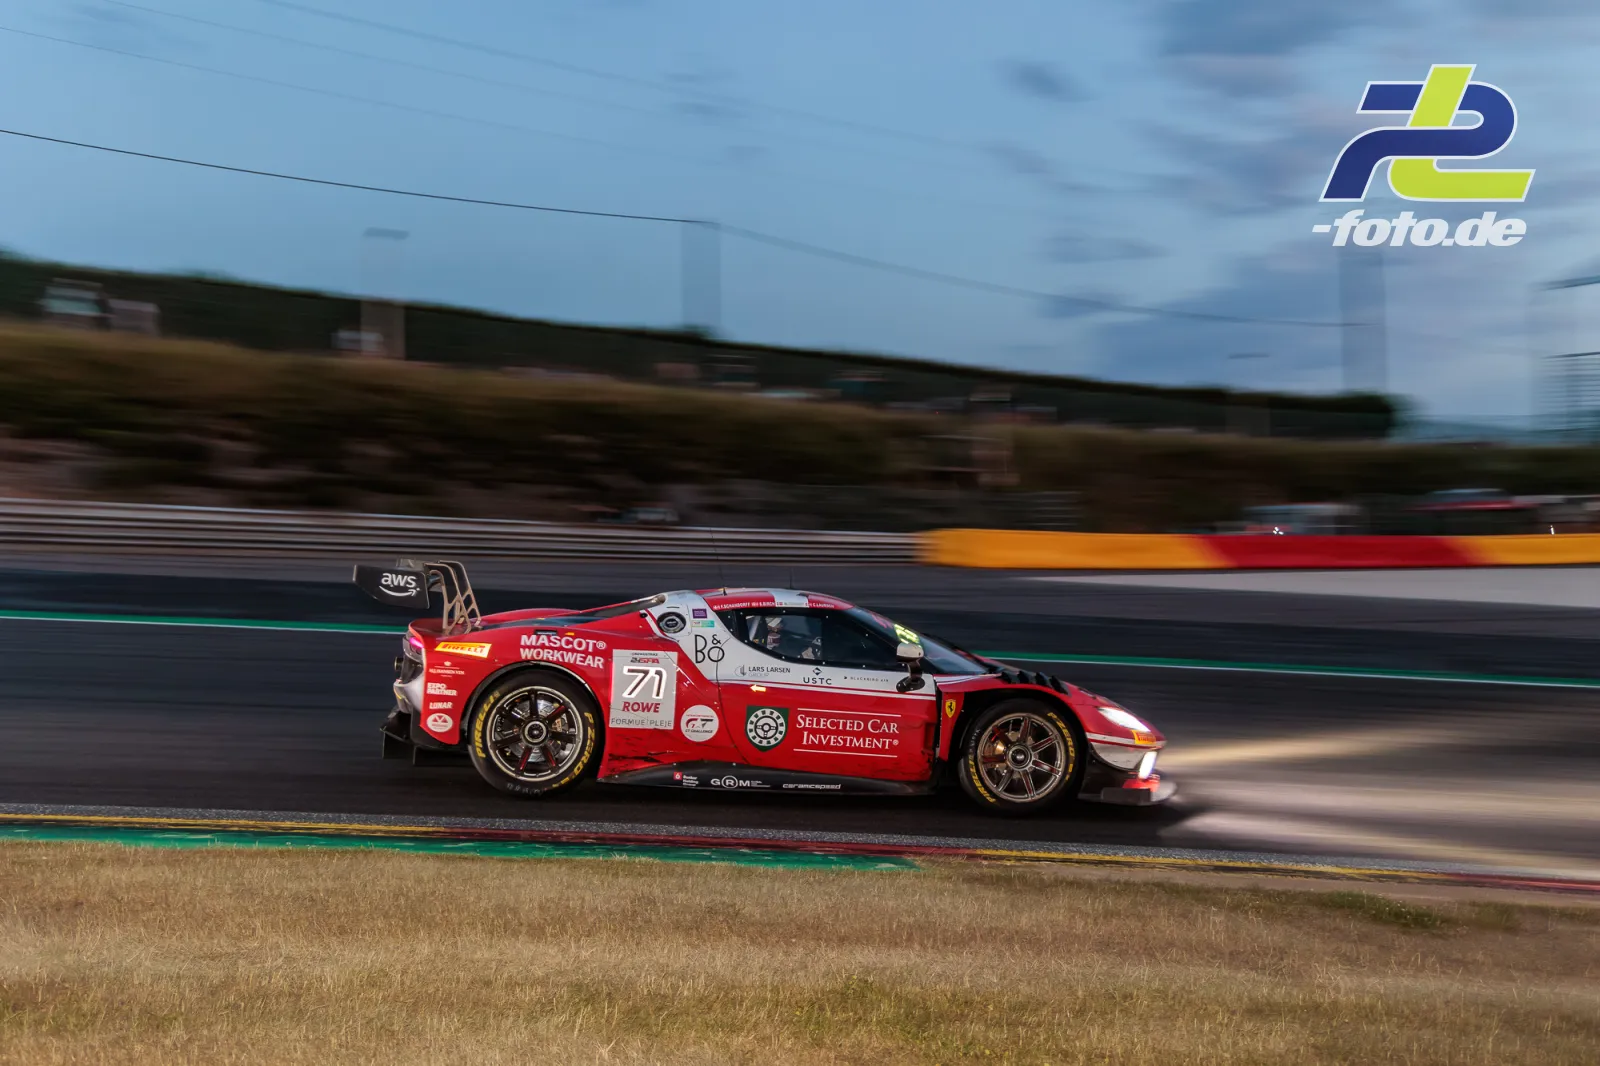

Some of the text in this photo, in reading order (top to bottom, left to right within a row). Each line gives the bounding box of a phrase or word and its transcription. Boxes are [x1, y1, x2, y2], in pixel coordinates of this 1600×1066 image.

[381, 572, 417, 588] aws
[519, 647, 605, 669] WORKWEAR
[766, 666, 791, 674] LARSEN
[621, 665, 668, 700] 71
[802, 676, 832, 685] USTC
[429, 702, 454, 710] LUNAR
[621, 701, 662, 713] ROWE
[796, 714, 900, 734] SELECTED CAR
[710, 776, 750, 788] GRM
